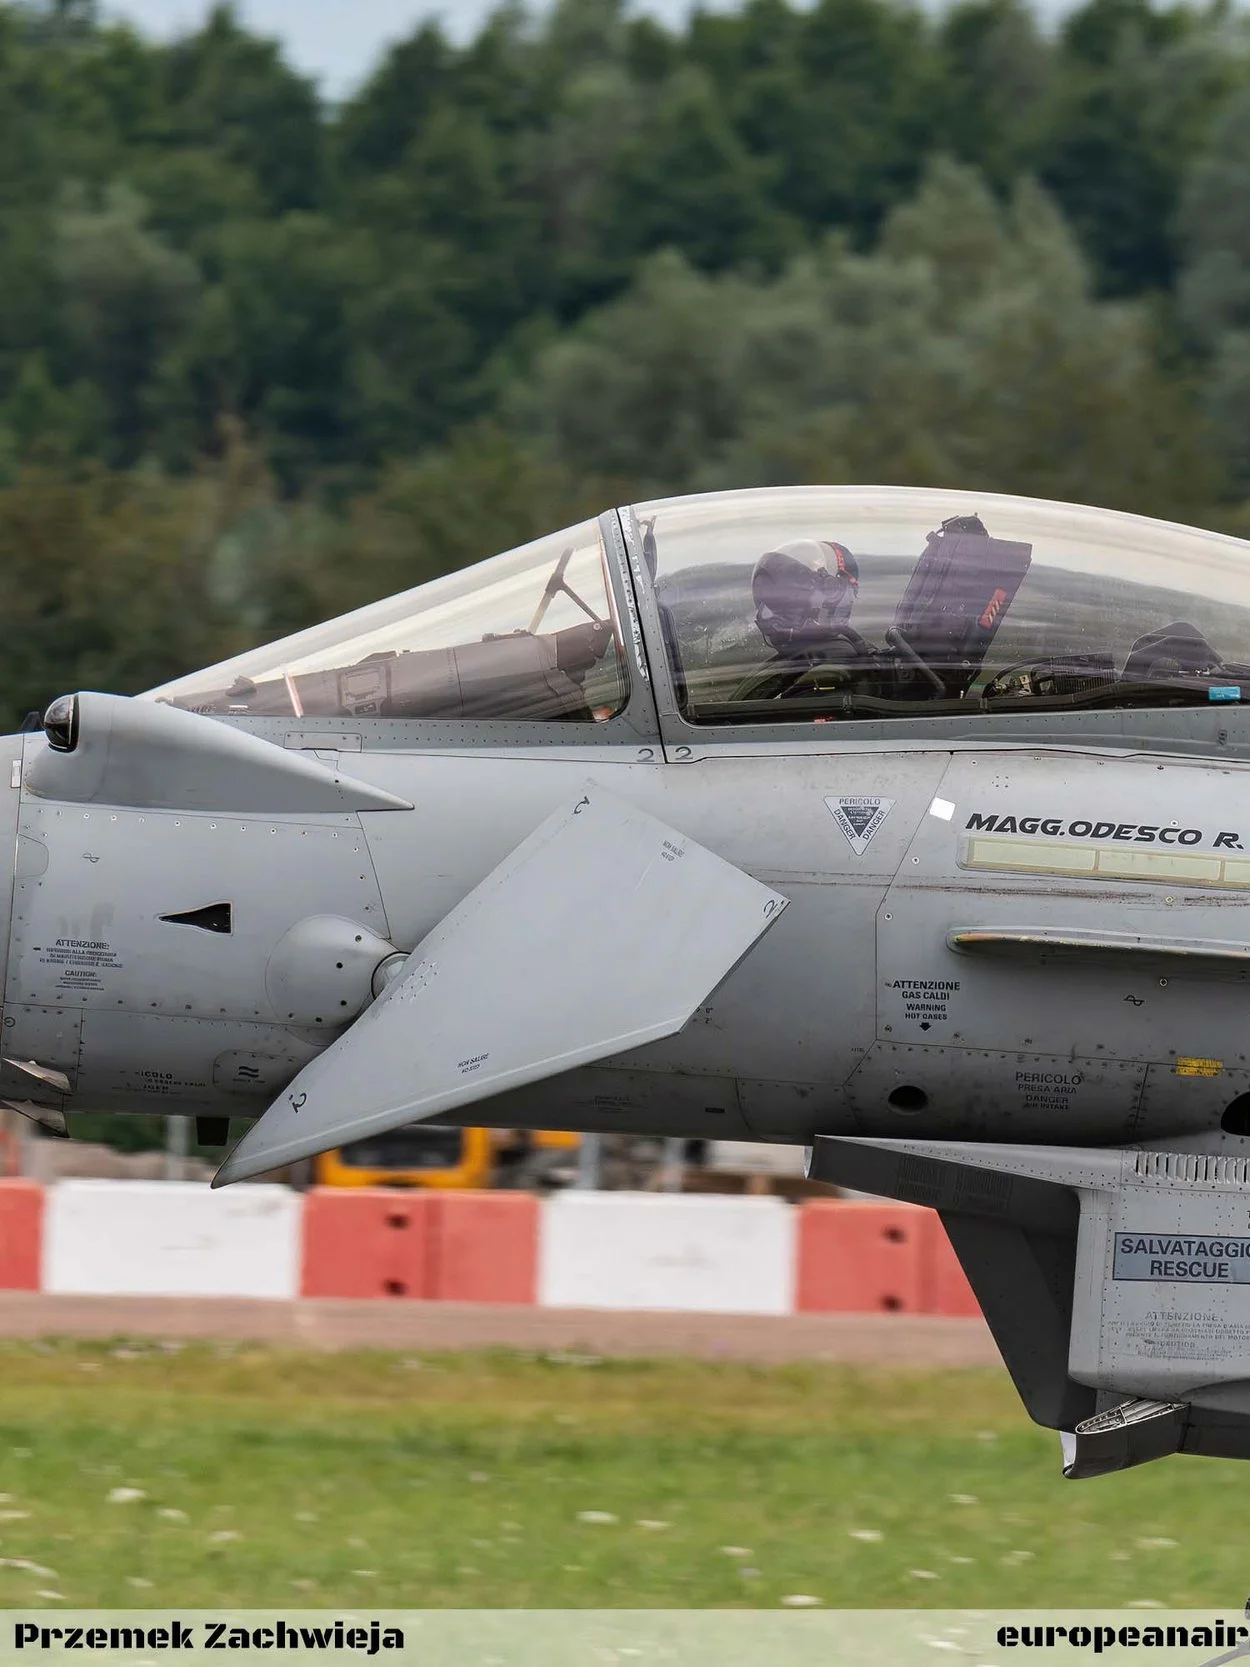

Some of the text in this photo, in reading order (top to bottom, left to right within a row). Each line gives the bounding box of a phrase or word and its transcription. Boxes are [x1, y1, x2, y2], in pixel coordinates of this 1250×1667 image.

[636, 748, 655, 762] 2
[675, 746, 693, 760] 2
[839, 797, 881, 805] PERICOLO
[833, 808, 856, 840] DANGER
[862, 810, 886, 840] DANGER
[965, 813, 1245, 850] MAGG.ODESCO R.
[892, 980, 961, 991] ATTENZIONE
[901, 991, 950, 1000] GAS CALDI
[906, 1003, 946, 1011] WARNING
[1015, 1071, 1082, 1085] PERICOLO
[1149, 1260, 1229, 1278] RESCUE
